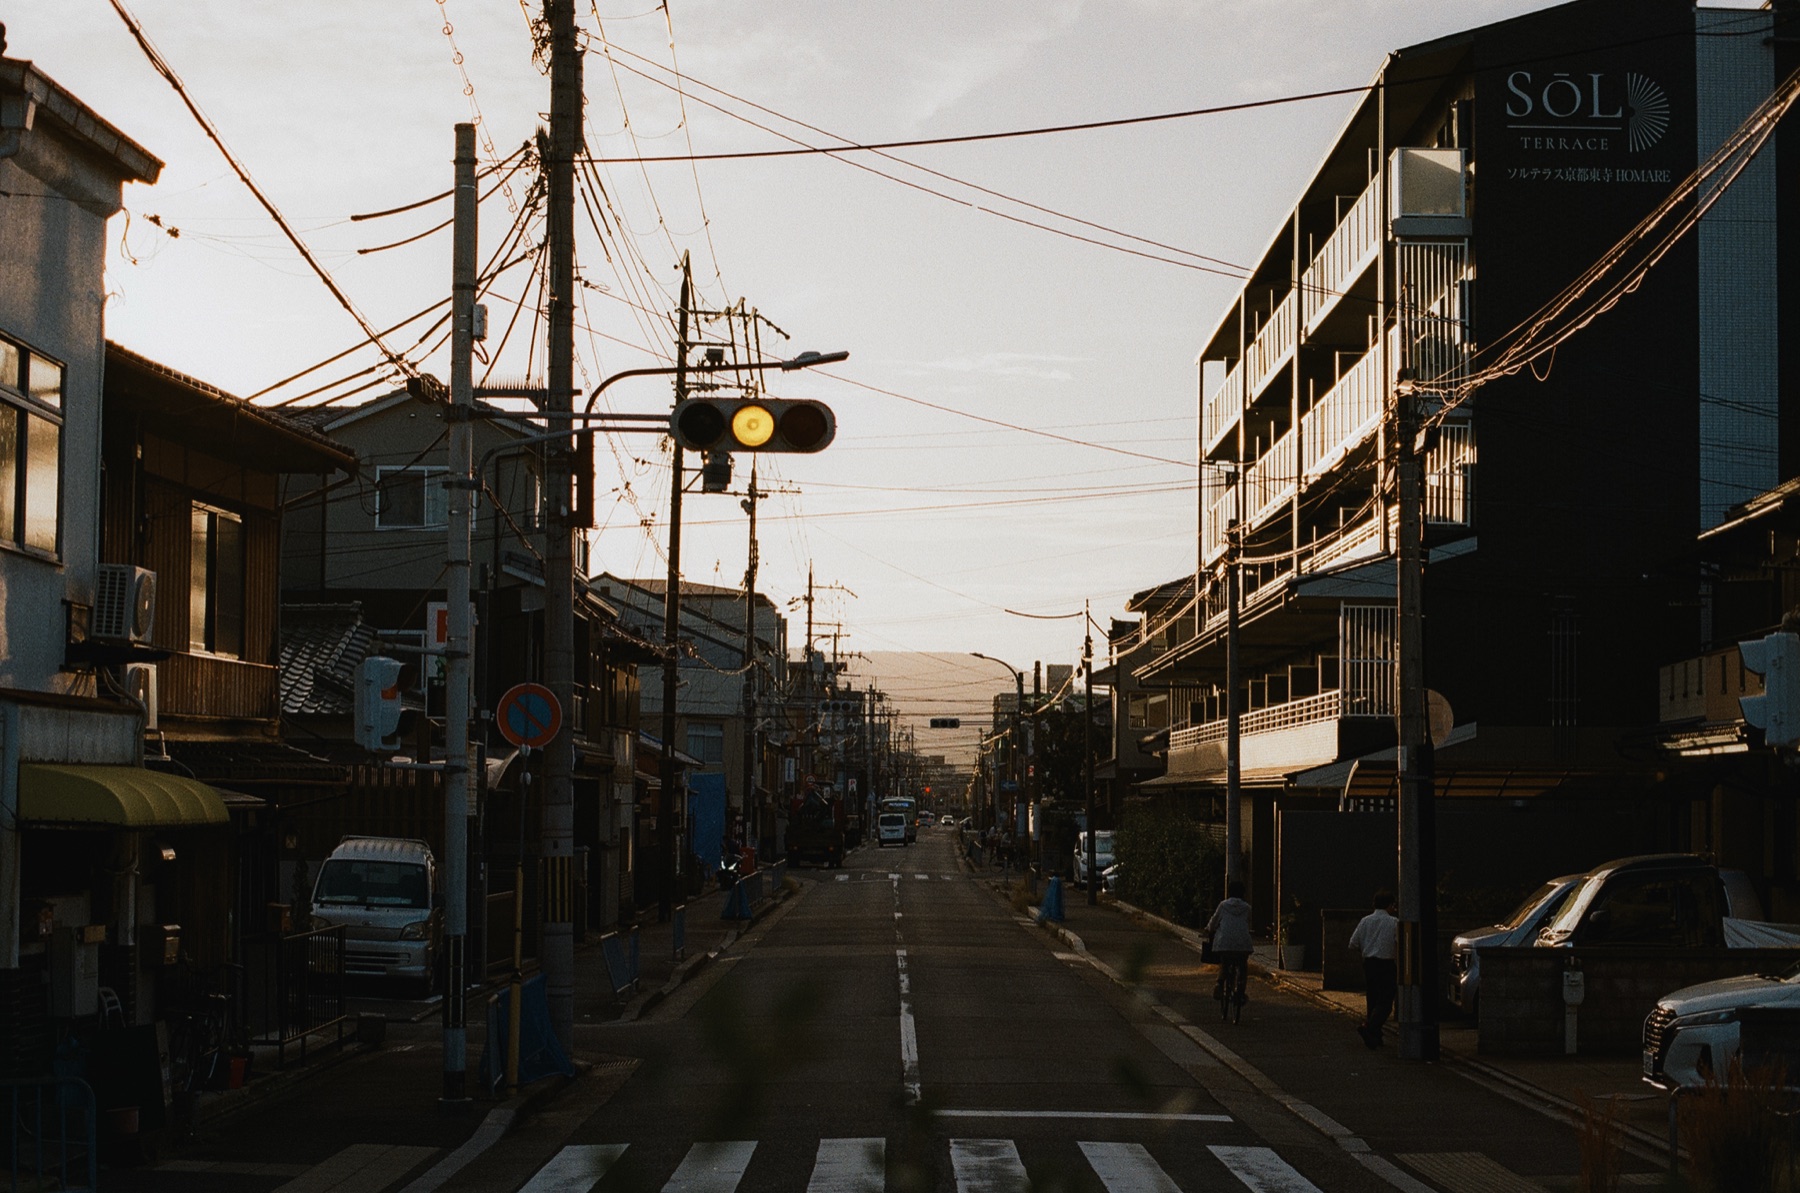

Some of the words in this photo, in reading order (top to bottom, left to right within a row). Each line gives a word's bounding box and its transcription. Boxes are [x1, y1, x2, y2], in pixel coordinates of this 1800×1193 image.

[1520, 136, 1609, 151] TERRACE
[1507, 167, 1613, 183] ソルテラス京都東寺
[1616, 169, 1671, 183] HOMARE
